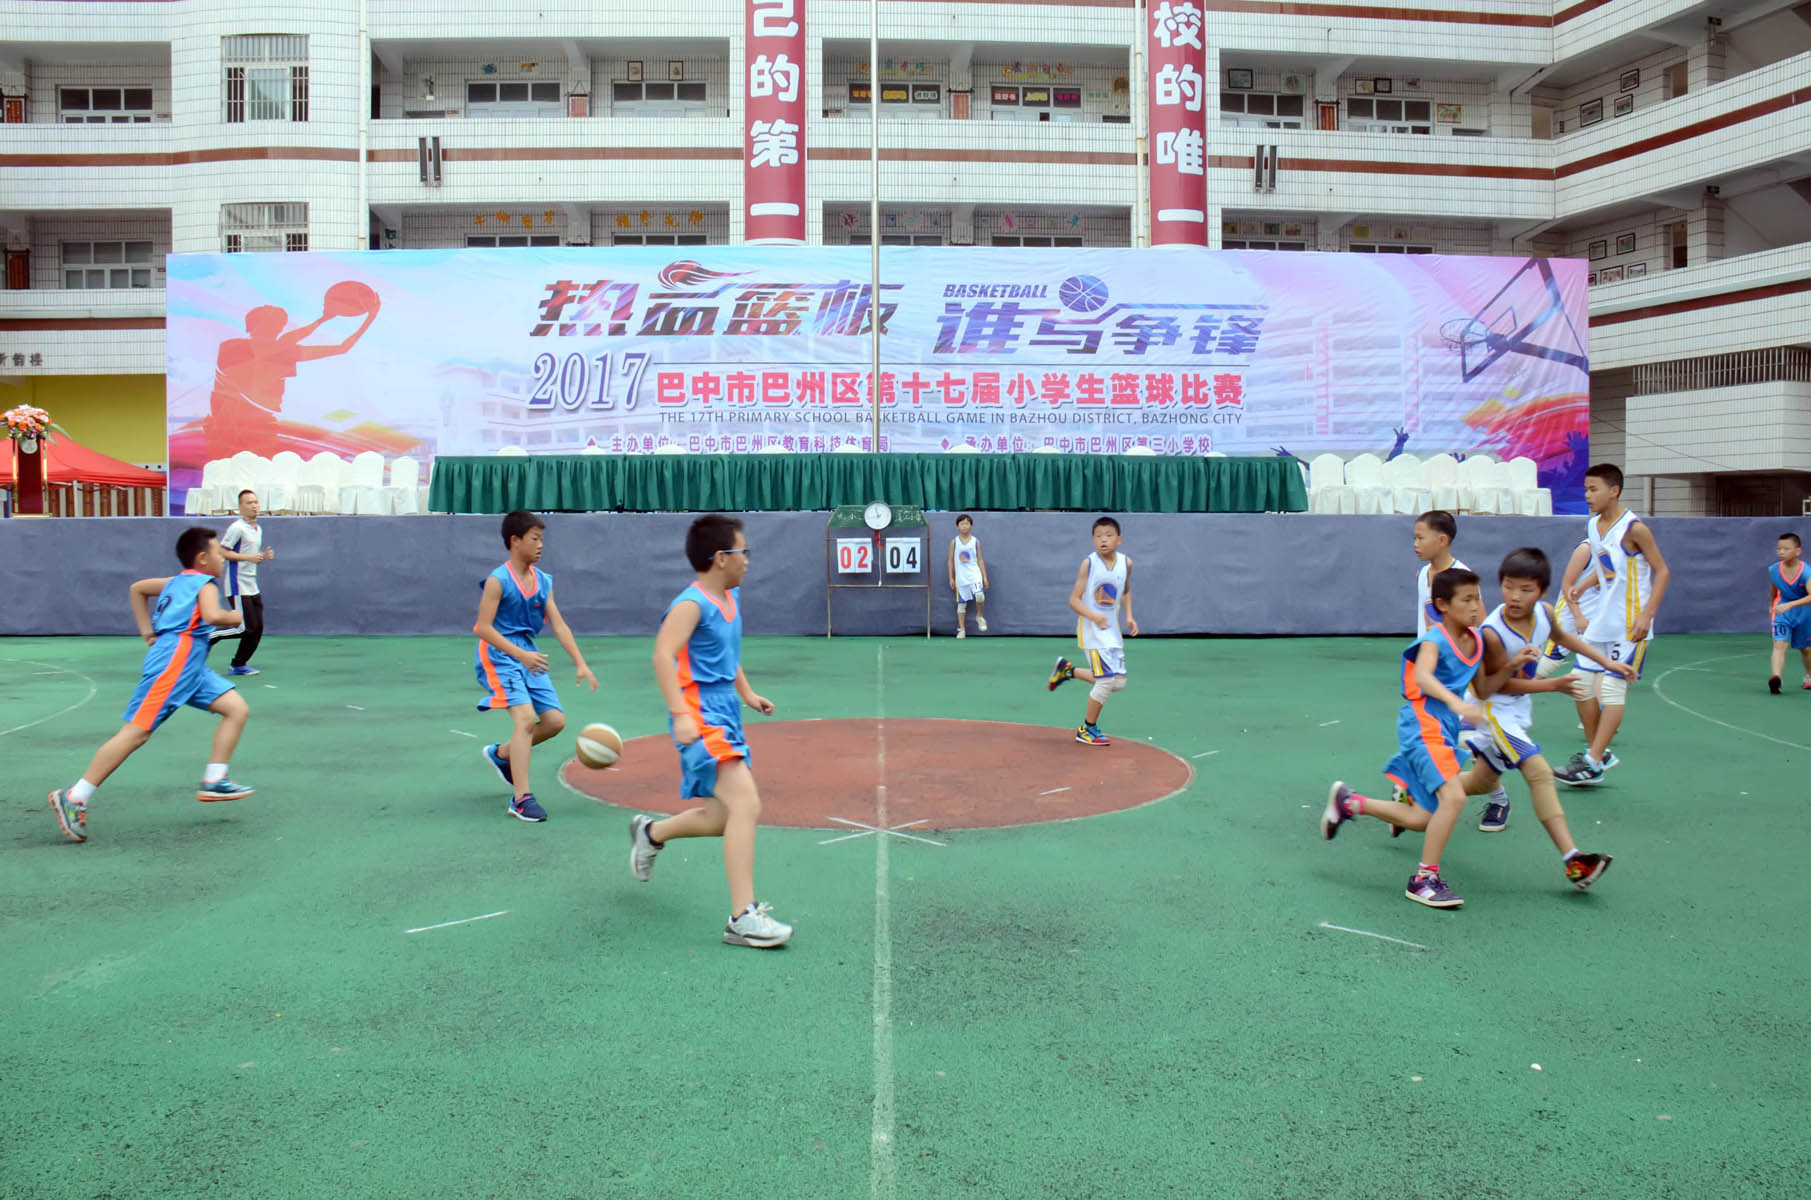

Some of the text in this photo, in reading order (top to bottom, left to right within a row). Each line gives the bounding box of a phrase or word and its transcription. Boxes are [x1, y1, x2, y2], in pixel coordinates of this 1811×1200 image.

[1154, 1, 1204, 223] 校的唯一
[529, 279, 904, 337] 热血篮板
[943, 284, 1048, 298] BASKETBALL
[932, 301, 1269, 355] 谁与争锋
[528, 352, 1245, 411] 2017 巴中市巴州区第十七届小学生篮球比赛
[659, 411, 1242, 425] THE 17TH PRIMARY SCHOOL BAKETBALL GAME IN BAZHOU DISTRICT, BAZHONG CITY
[840, 546, 917, 569] 02 04
[1611, 644, 1621, 661] 5
